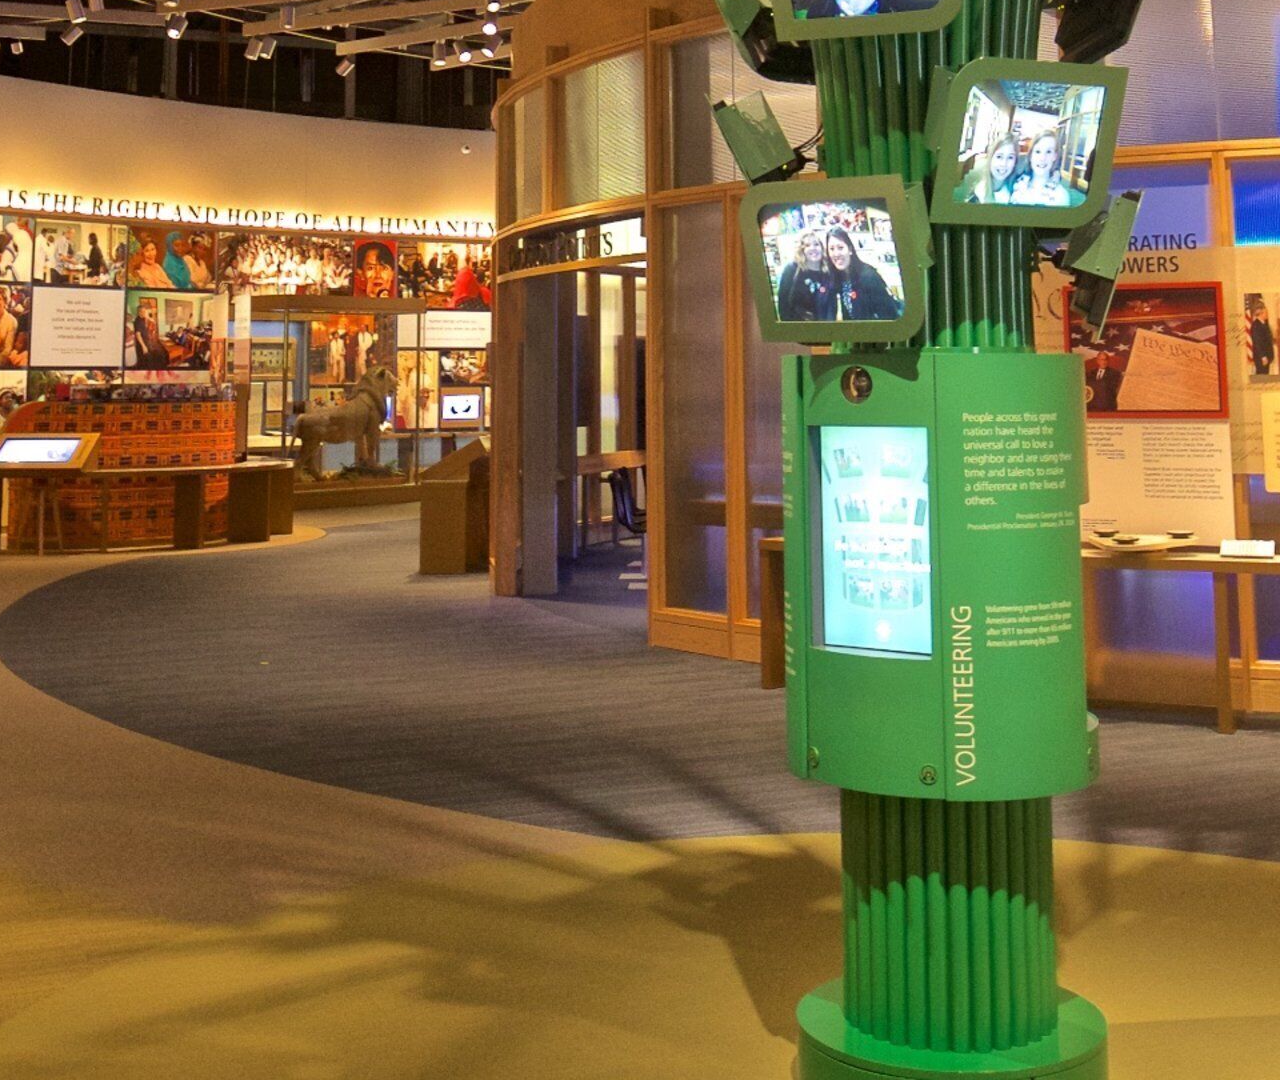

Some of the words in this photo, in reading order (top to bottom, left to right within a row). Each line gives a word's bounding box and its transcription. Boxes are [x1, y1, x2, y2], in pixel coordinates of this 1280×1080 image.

[7, 189, 27, 207] IS
[37, 192, 83, 211] THE
[91, 196, 165, 218] RIGHT
[173, 204, 219, 222] AND
[227, 208, 286, 224] HOPE
[295, 212, 323, 228] OF
[332, 215, 368, 232] ALL
[378, 217, 496, 239] HUMANITY
[1127, 232, 1197, 252] RATING
[962, 412, 993, 424] People
[995, 414, 1022, 423] across
[1023, 412, 1038, 422] this
[1039, 413, 1057, 423] great
[963, 427, 993, 436] nation
[995, 425, 1016, 436] have
[1017, 425, 1040, 435] heard
[1042, 425, 1054, 435] the
[963, 439, 1004, 450] universal
[1005, 439, 1020, 449] call
[1022, 440, 1031, 449] to
[1032, 439, 1048, 449] love
[963, 454, 1005, 466] neighbor
[1007, 453, 1024, 463] and
[1025, 454, 1038, 463] are
[1039, 454, 1059, 464] using
[964, 468, 986, 478] time
[987, 467, 1005, 477] and
[1007, 467, 1035, 477] talents
[1036, 467, 1045, 476] to
[973, 481, 1018, 492] difference
[1020, 481, 1028, 490] in
[1029, 480, 1042, 490] the
[964, 495, 997, 506] others.
[951, 606, 976, 786] VOLUNTEERING
